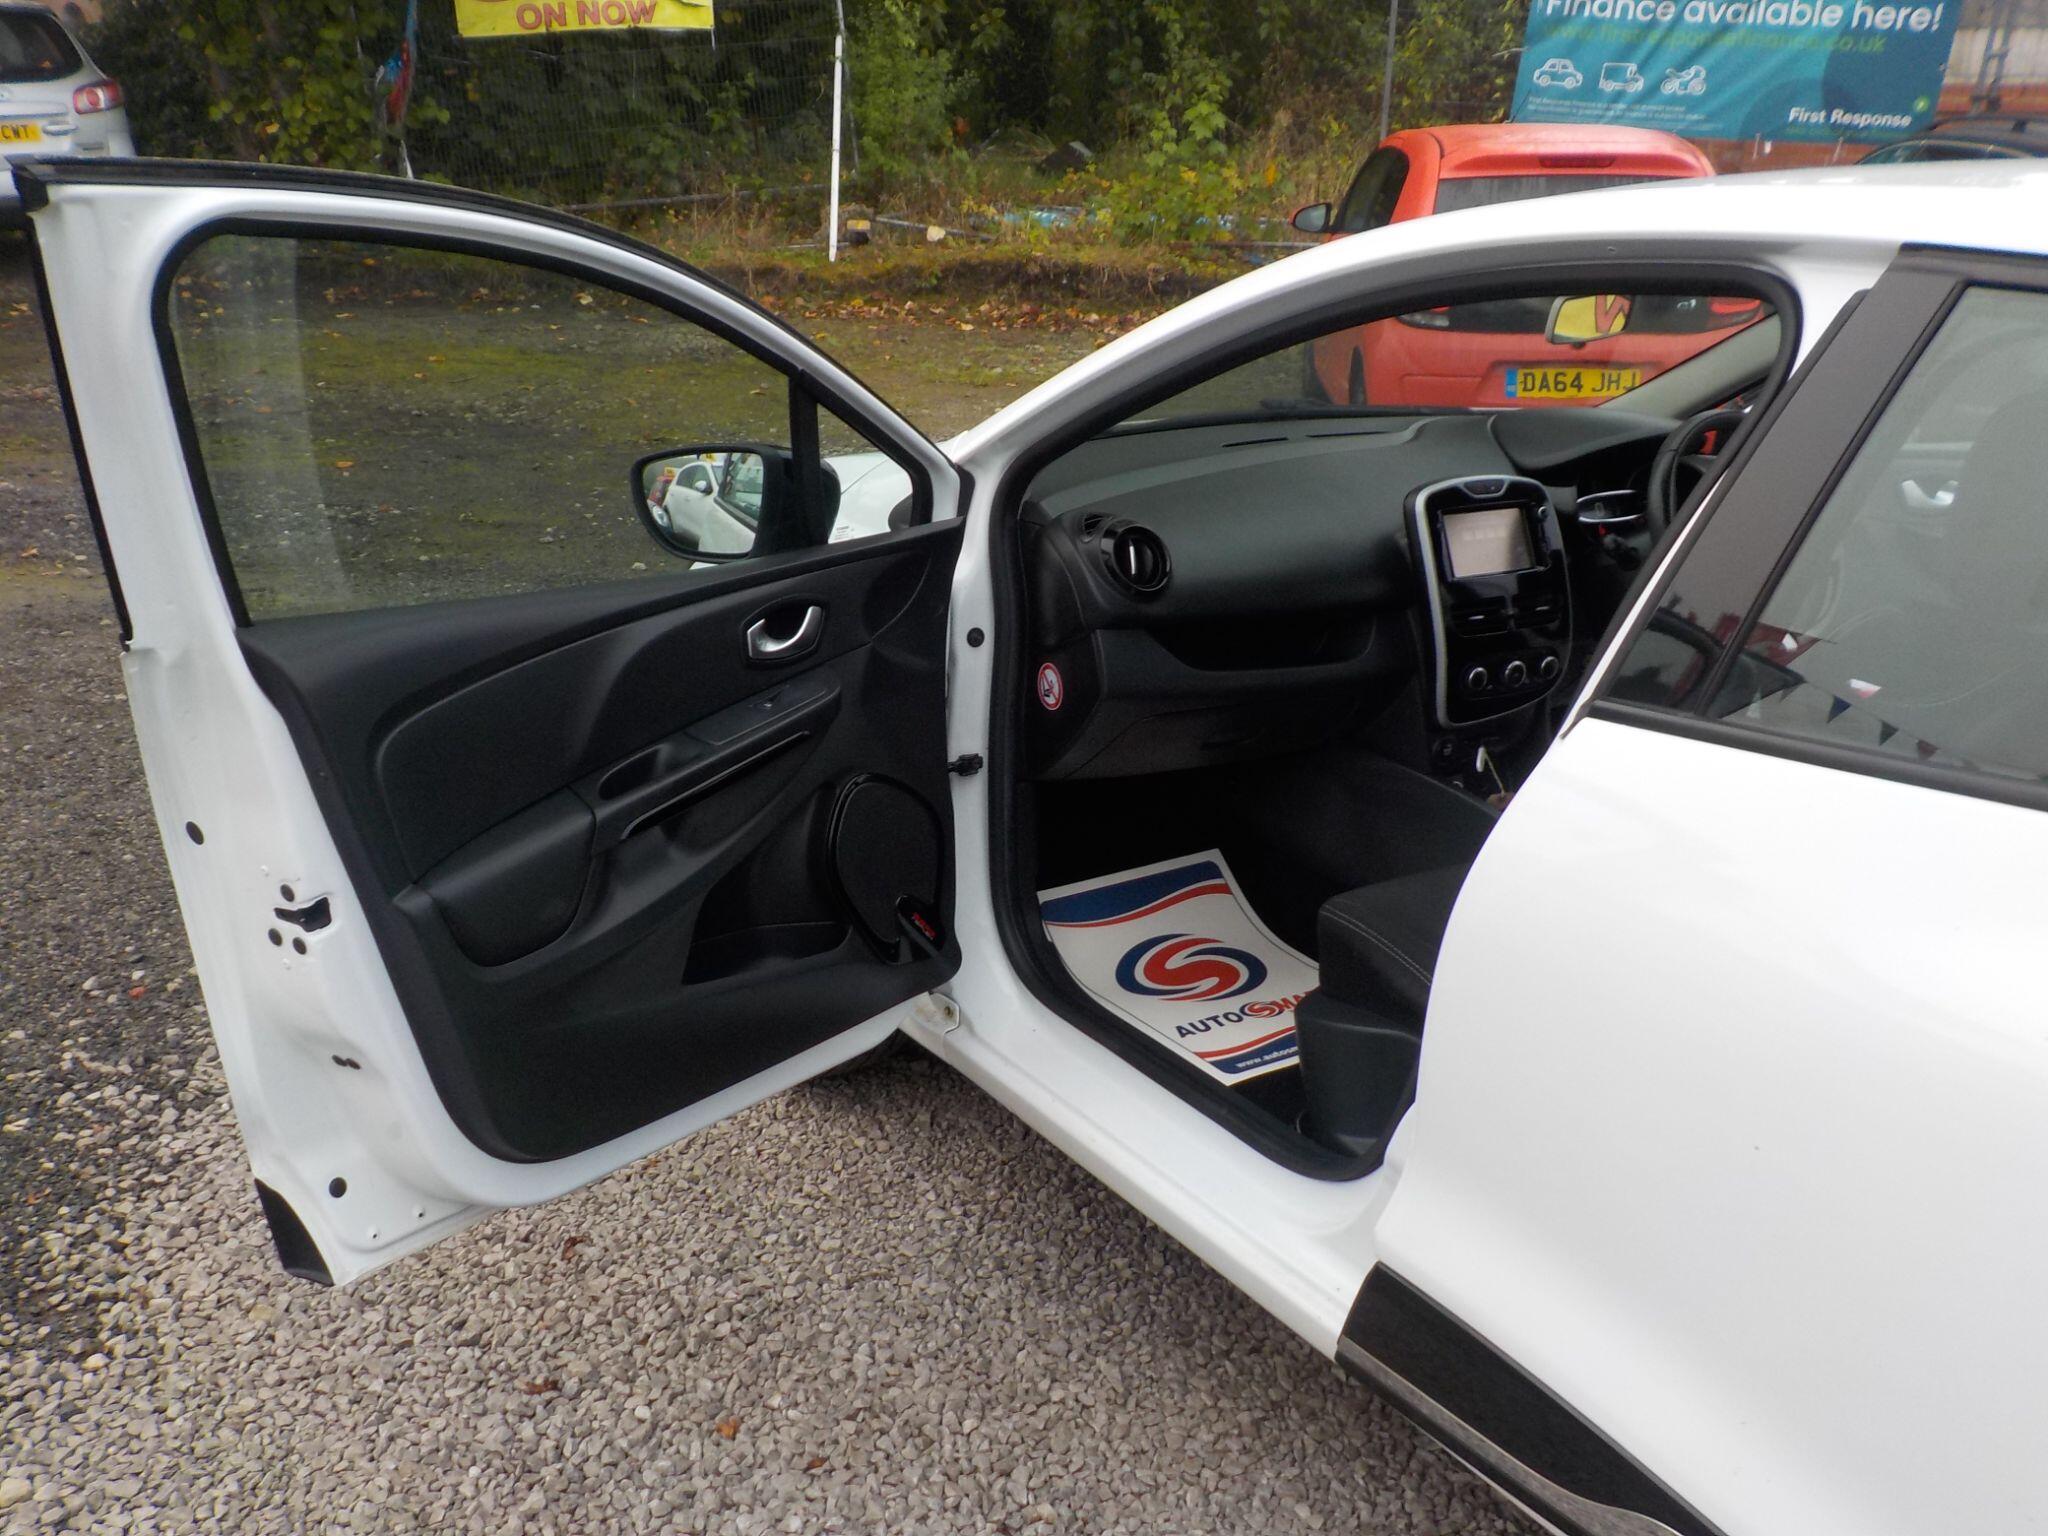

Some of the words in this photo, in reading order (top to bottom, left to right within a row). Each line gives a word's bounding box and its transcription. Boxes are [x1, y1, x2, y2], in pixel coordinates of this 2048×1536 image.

[515, 2, 567, 30] ON
[576, 0, 656, 25] NOW
[1546, 0, 1676, 21] Finance
[1683, 0, 1844, 27] available
[1851, 0, 1945, 32] here!
[1789, 107, 1827, 123] First
[1830, 108, 1912, 128] Response
[1522, 371, 1583, 393] DA64
